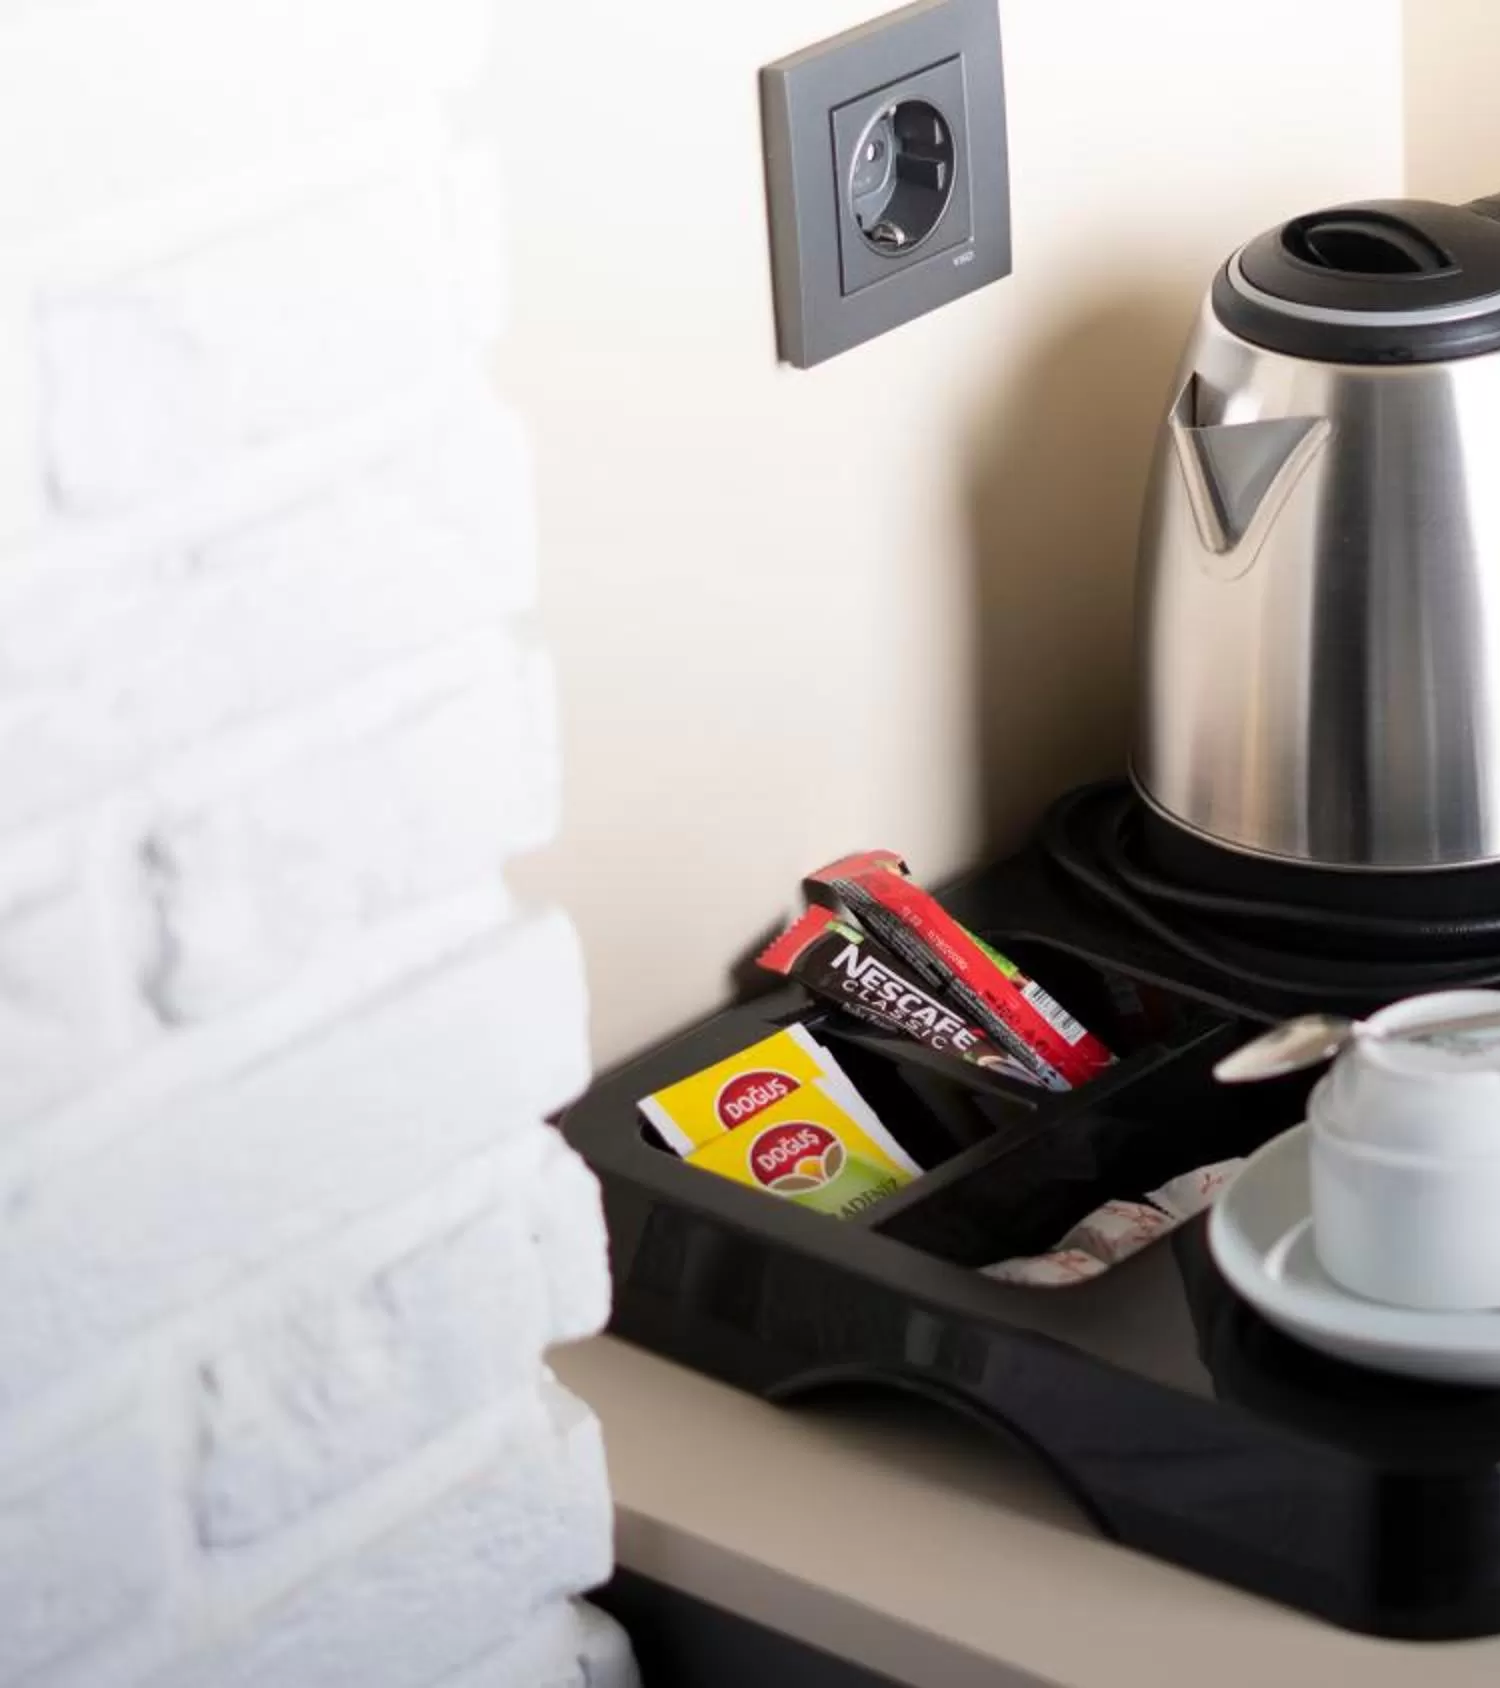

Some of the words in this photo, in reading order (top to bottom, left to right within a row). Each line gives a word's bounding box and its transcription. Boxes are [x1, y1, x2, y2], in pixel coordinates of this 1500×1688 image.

[841, 979, 947, 1050] CLASSIC
[725, 1077, 788, 1121] DOĞUŞ
[757, 1127, 820, 1173] DOĞUŞ
